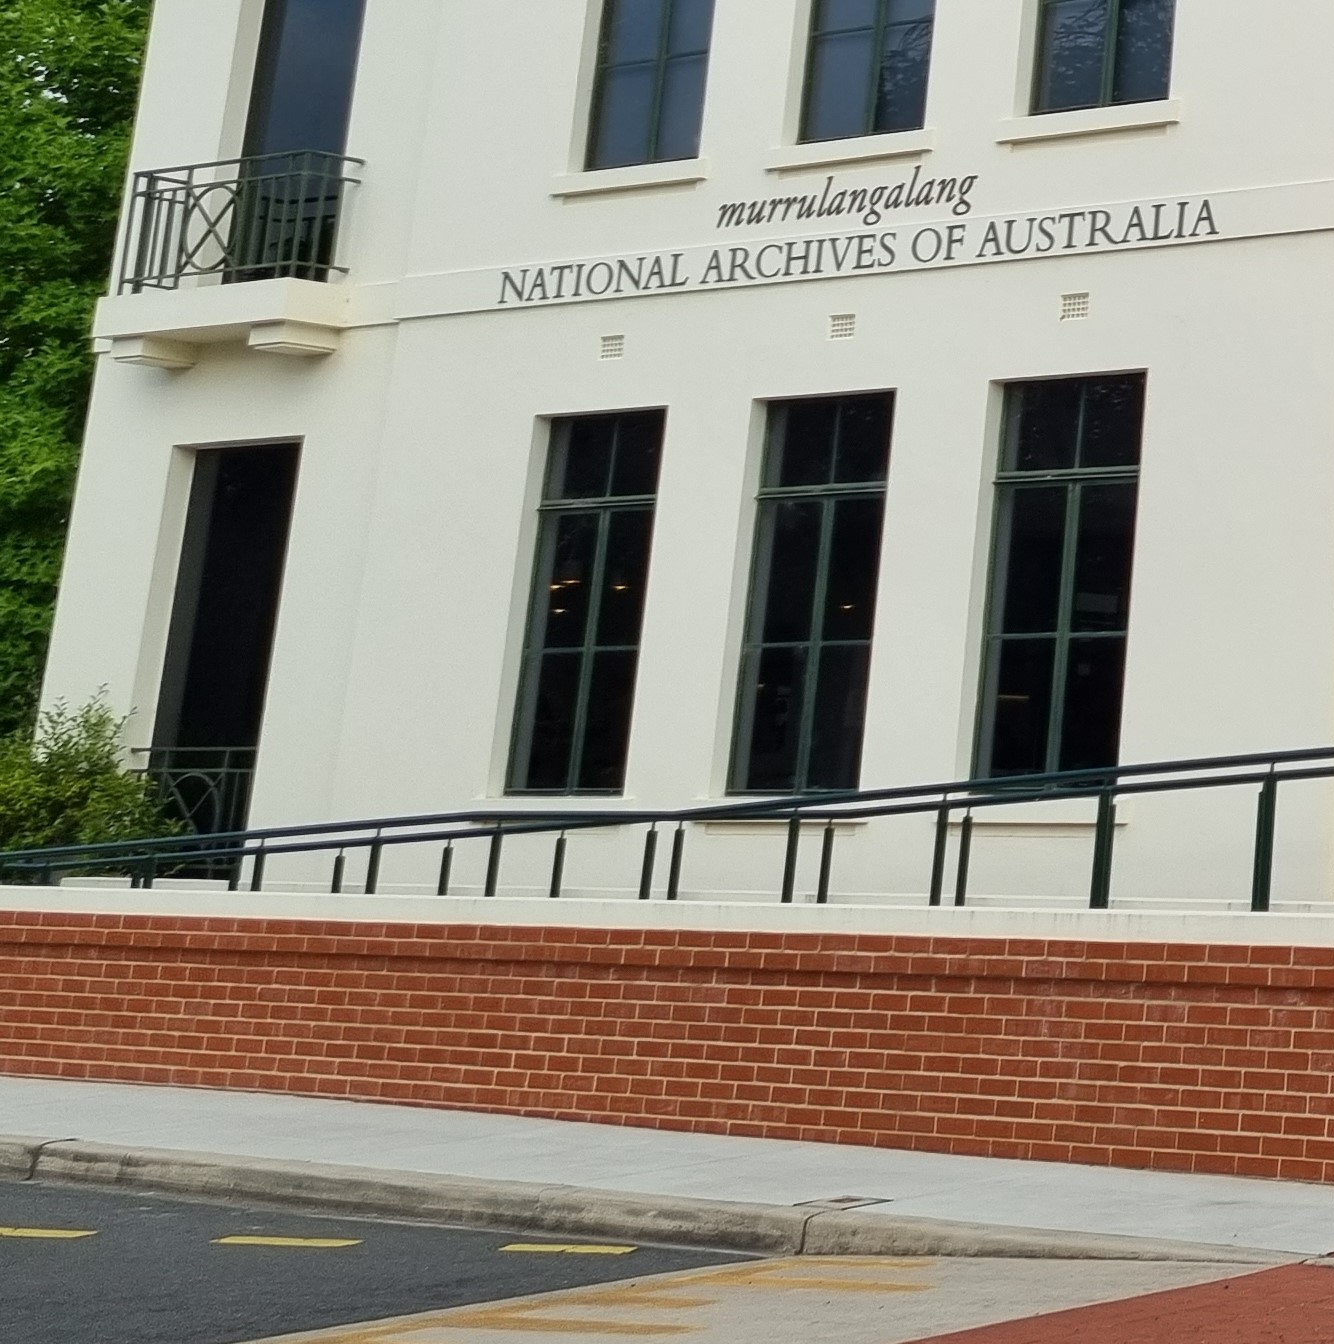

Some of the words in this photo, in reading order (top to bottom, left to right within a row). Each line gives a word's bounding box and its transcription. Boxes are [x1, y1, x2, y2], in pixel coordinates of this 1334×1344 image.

[716, 165, 978, 227] murrulangalang
[497, 253, 690, 305] NATIONAL
[699, 231, 898, 284] ARCHIVES
[911, 224, 967, 264] OF
[975, 199, 1220, 258] AUSTRALIA
